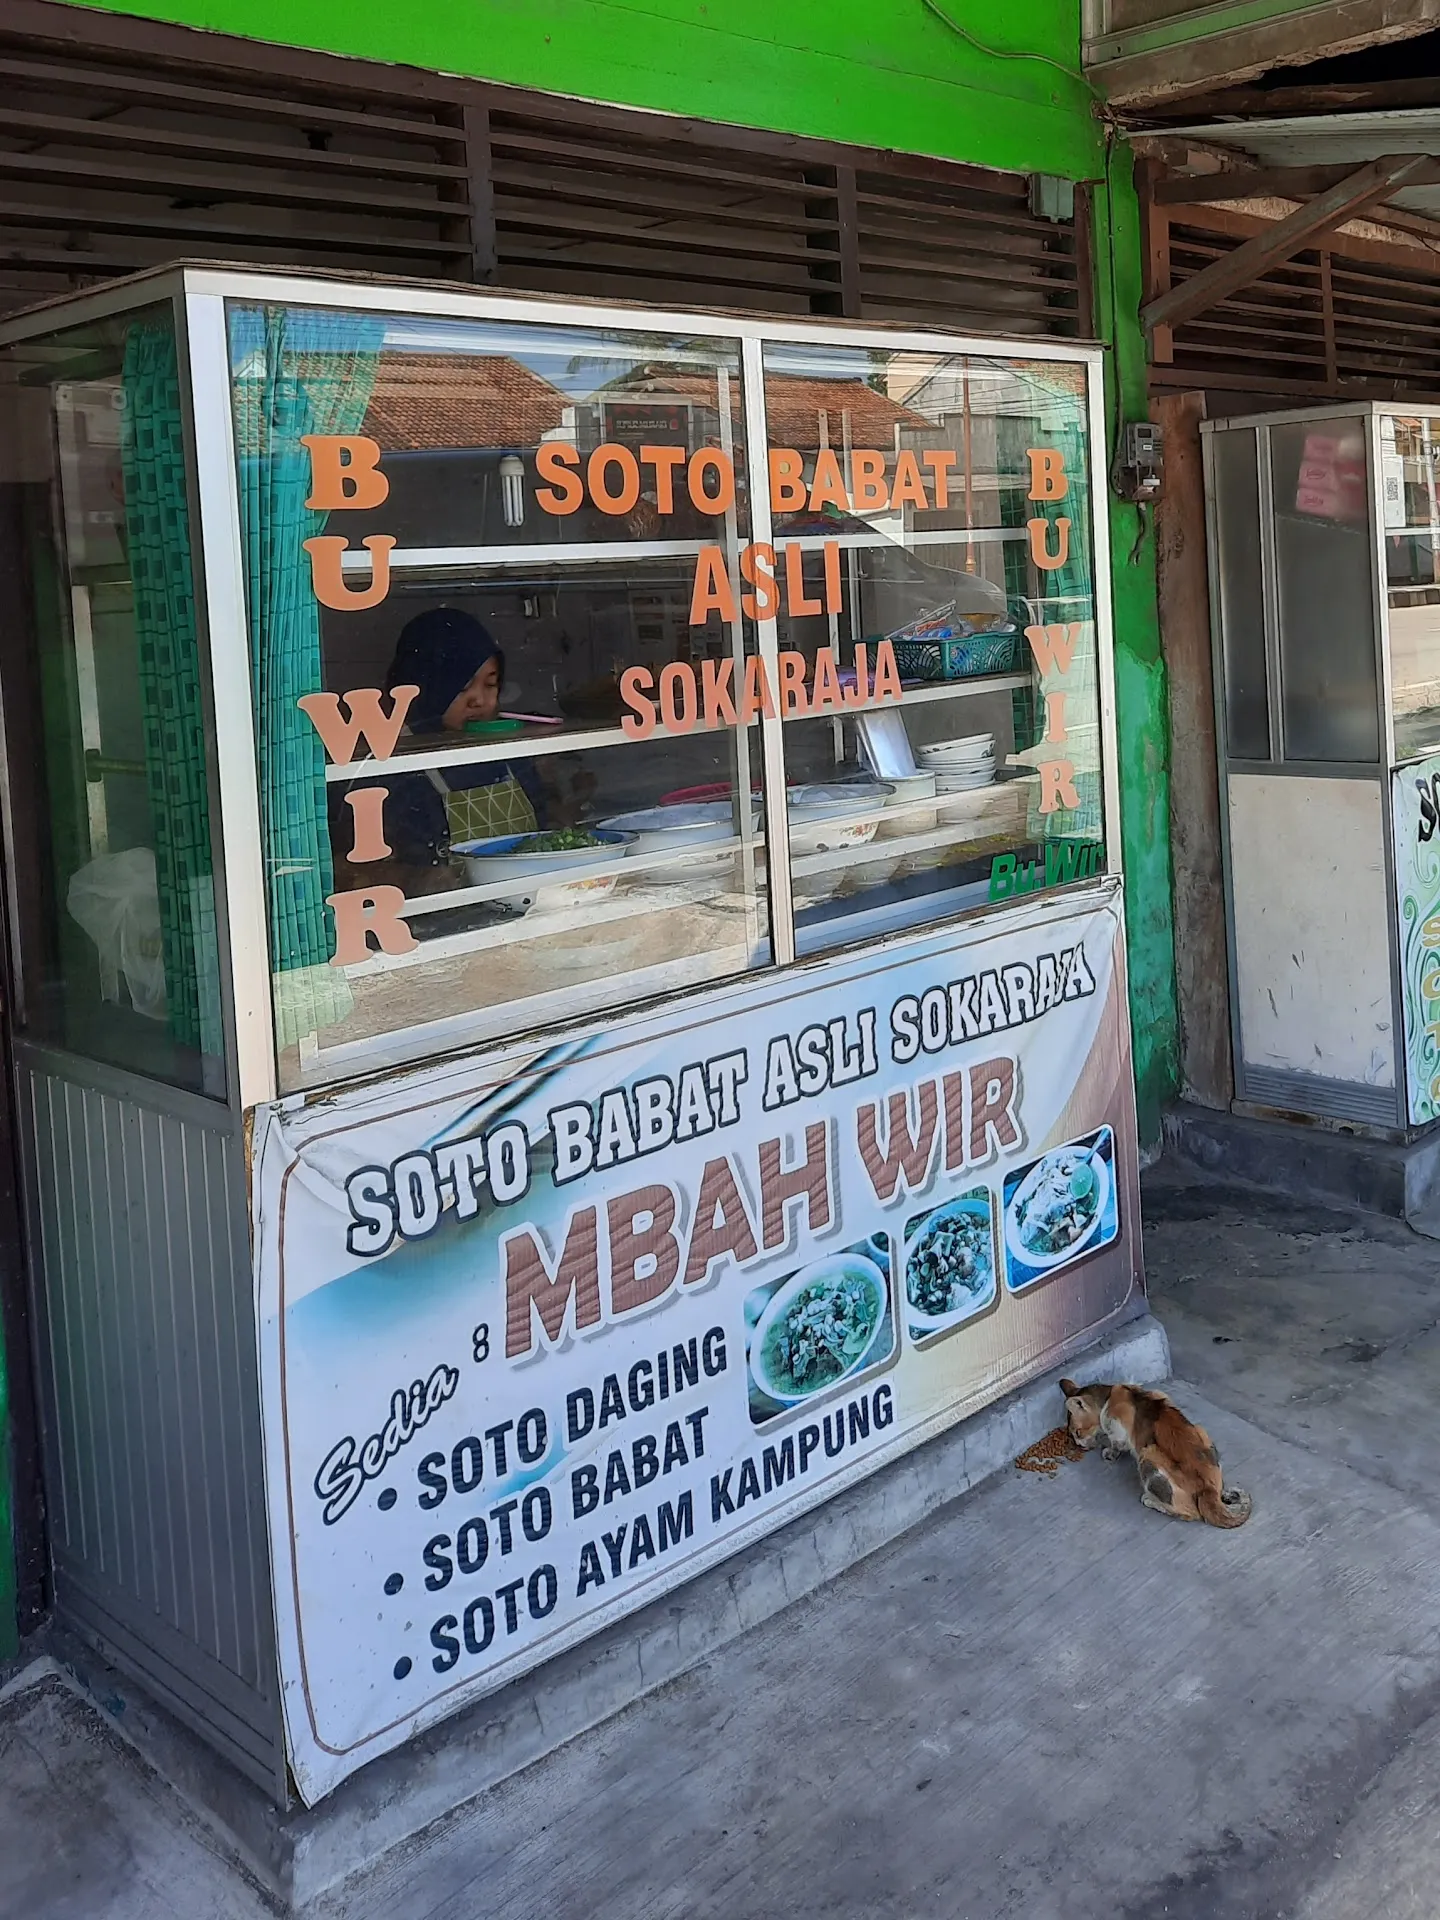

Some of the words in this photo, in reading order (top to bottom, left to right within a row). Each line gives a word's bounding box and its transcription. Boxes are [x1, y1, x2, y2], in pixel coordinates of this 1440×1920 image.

[301, 434, 397, 612] BU
[535, 441, 735, 516] SOTO
[769, 448, 957, 513] BABAT
[688, 540, 843, 626] ASLI
[619, 638, 903, 740] SOKARAJA
[297, 683, 420, 967] WIR
[345, 1119, 532, 1257] SOTO
[547, 1047, 749, 1188] BABAT
[762, 1006, 879, 1112] ASLI
[502, 1119, 832, 1360] MBAH
[855, 1055, 1020, 1202] WIR
[313, 1363, 460, 1526] Sedia
[417, 1407, 548, 1511] SOTO
[565, 1325, 728, 1444] DAGING
[422, 1486, 552, 1592] SOTO
[571, 1405, 709, 1520] BABAT
[429, 1563, 558, 1675] SOTO
[576, 1489, 695, 1598] AYAM
[710, 1383, 894, 1524] KAMPUNG
